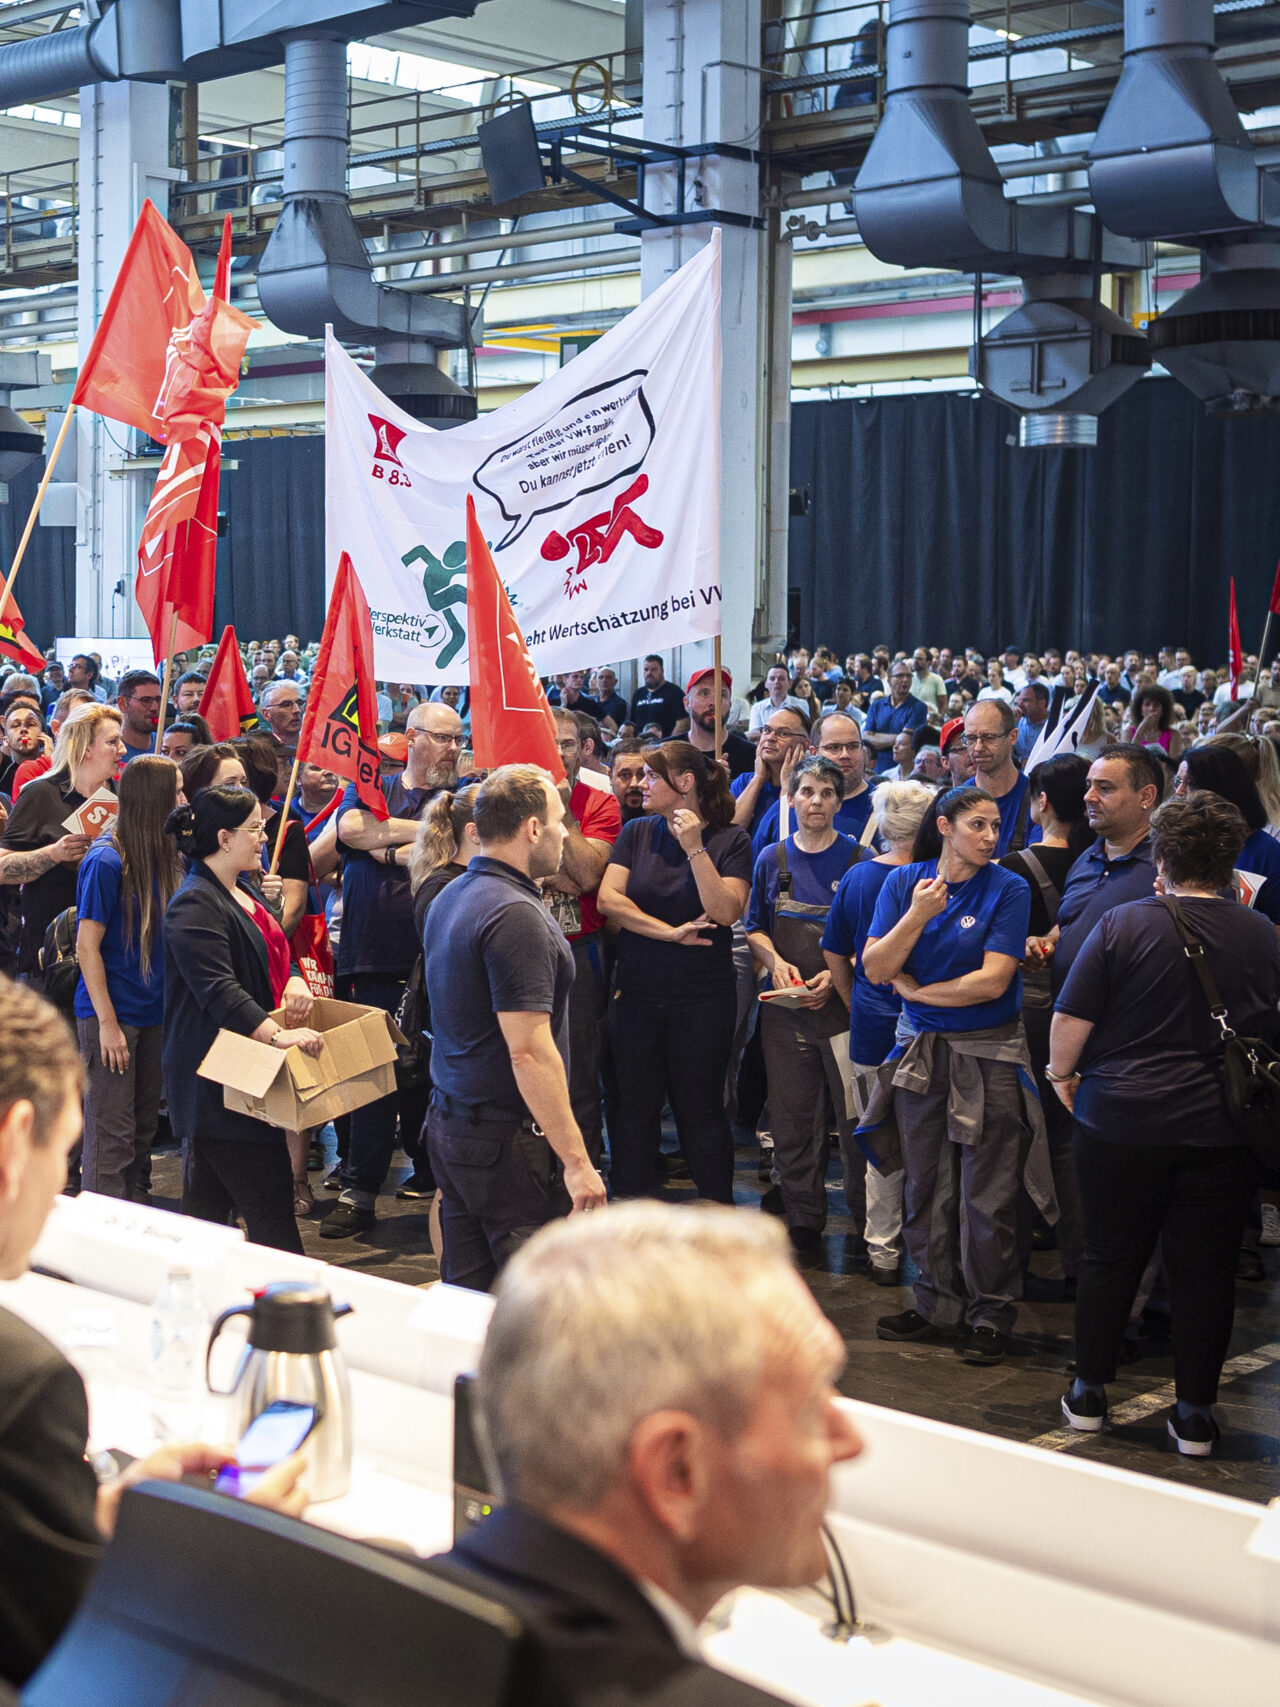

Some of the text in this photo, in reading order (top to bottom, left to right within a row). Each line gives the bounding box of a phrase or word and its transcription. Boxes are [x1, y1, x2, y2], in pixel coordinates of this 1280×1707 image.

[532, 428, 564, 448] fleißig
[562, 417, 583, 433] und
[584, 408, 601, 421] ein
[372, 464, 412, 487] B 8.3
[519, 480, 538, 494] Du
[573, 455, 597, 478] jetzt
[527, 457, 550, 471] aber
[551, 450, 567, 464] wir
[368, 607, 426, 628] erspektiv
[524, 630, 546, 648] eht
[549, 600, 669, 641] Wertschätzung
[671, 589, 696, 613] bei
[321, 721, 352, 758] IG
